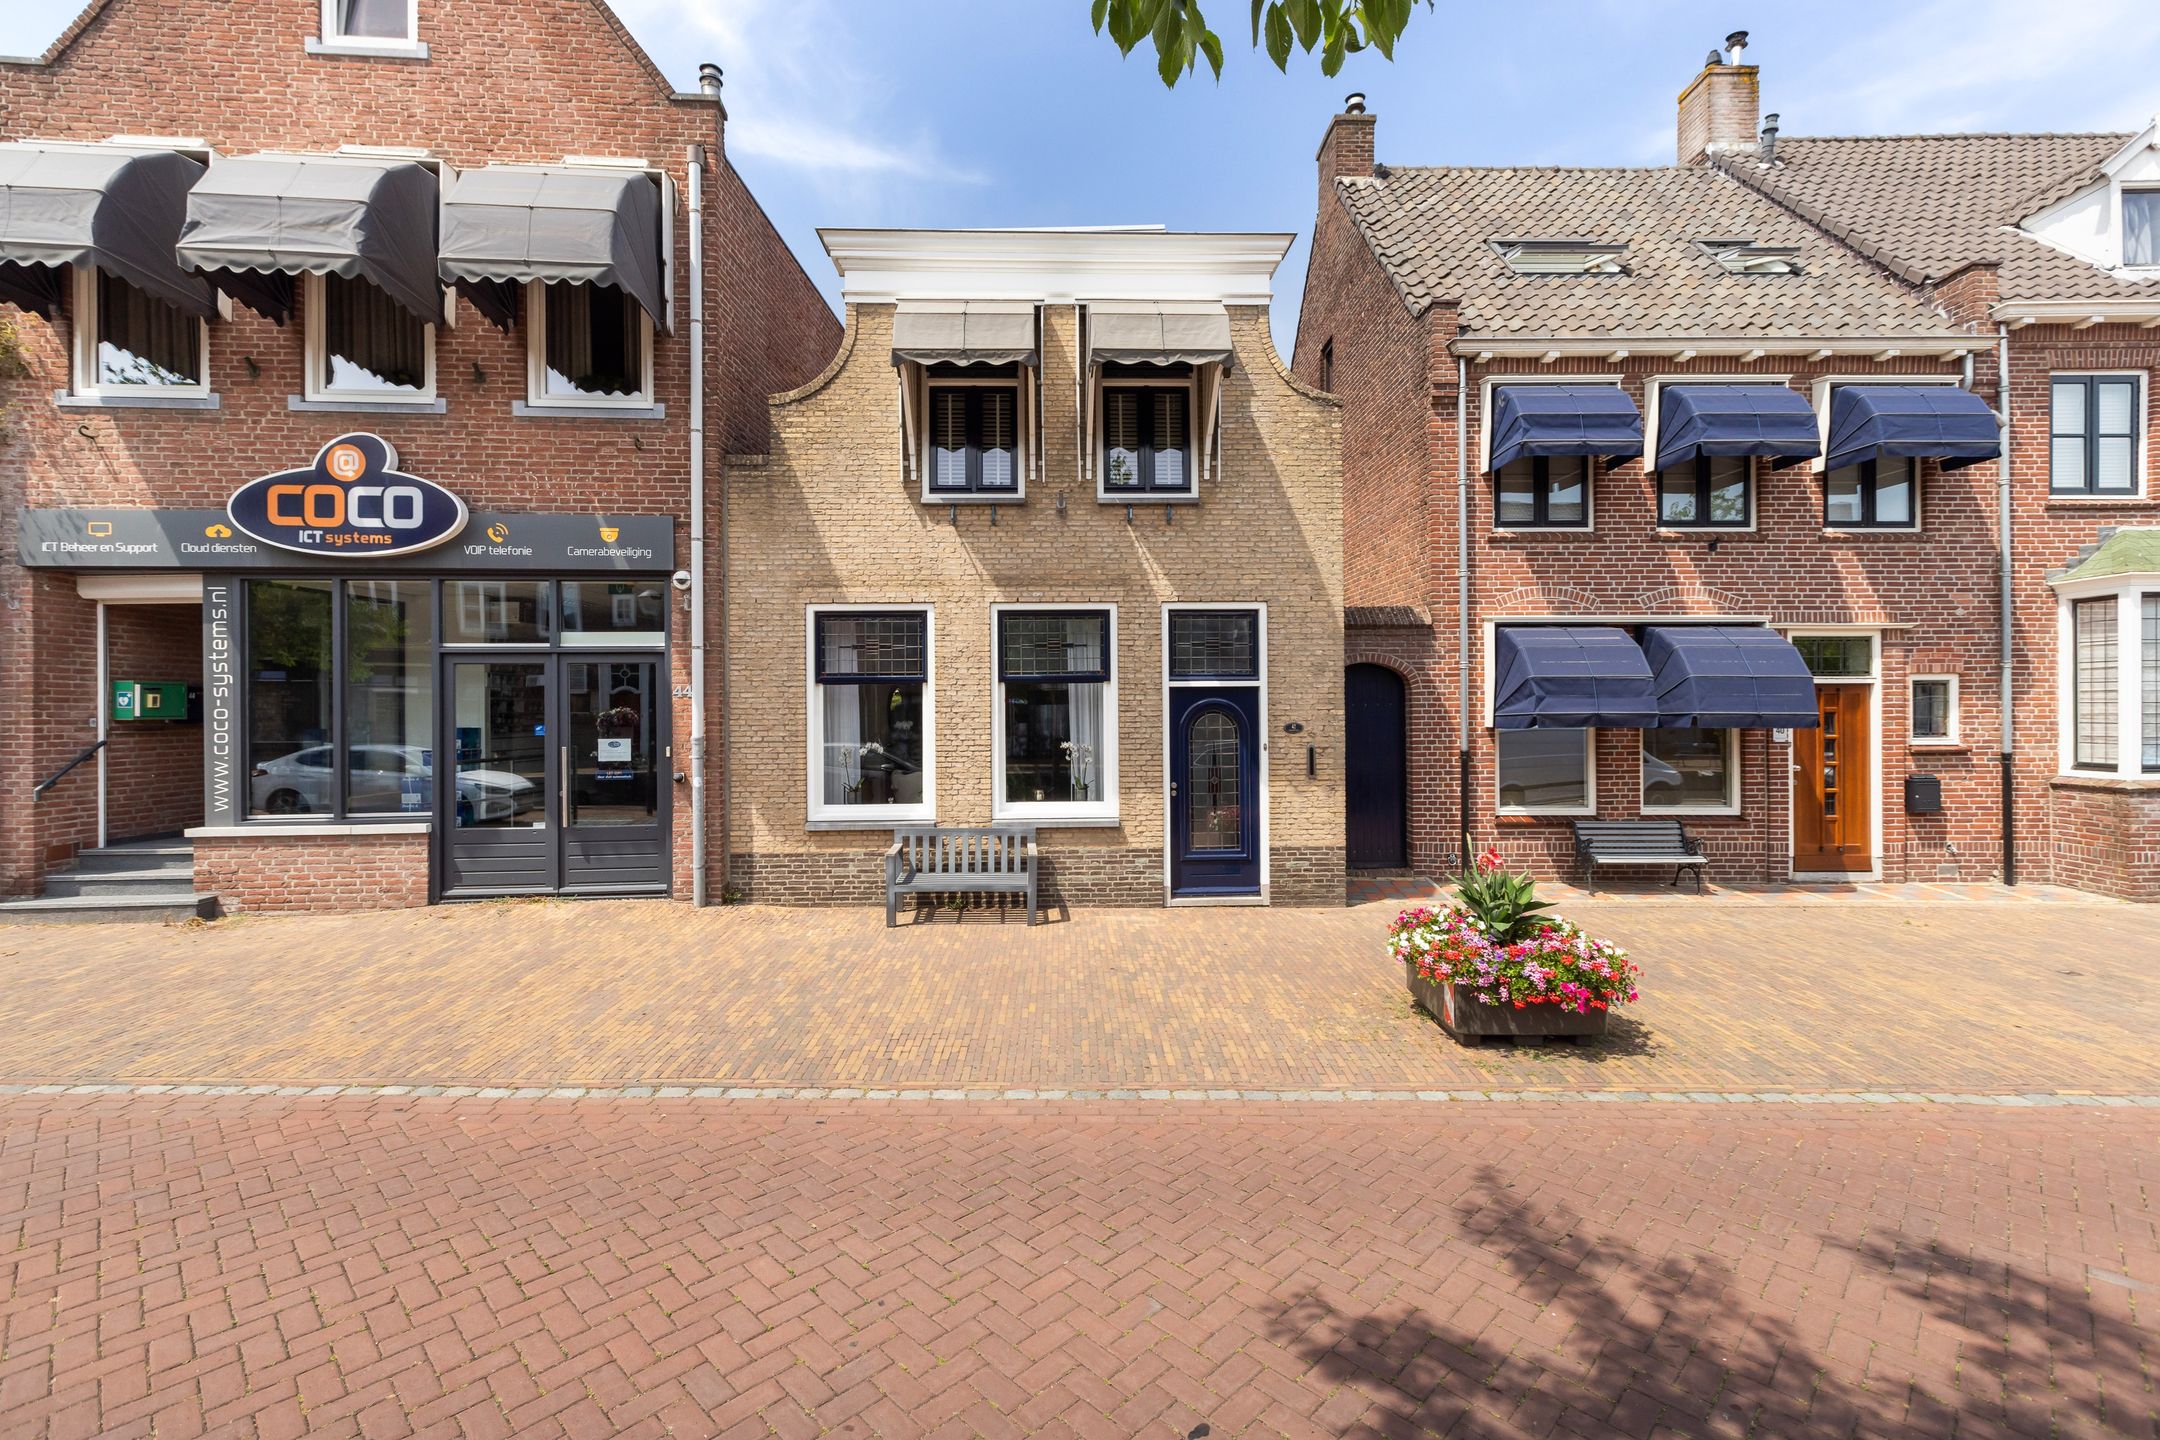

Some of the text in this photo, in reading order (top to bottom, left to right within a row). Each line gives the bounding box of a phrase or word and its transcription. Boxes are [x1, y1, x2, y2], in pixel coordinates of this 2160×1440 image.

[266, 484, 424, 529] COCO
[298, 530, 393, 547] ICT systems
[41, 541, 159, 555] ICT Beheer en Support
[181, 542, 257, 553] Cloud diensten
[463, 545, 533, 556] VOIP telefonie
[567, 546, 652, 559] Camerabeveiliging
[673, 684, 692, 698] 44
[207, 586, 233, 812] www.coco-systems.nl
